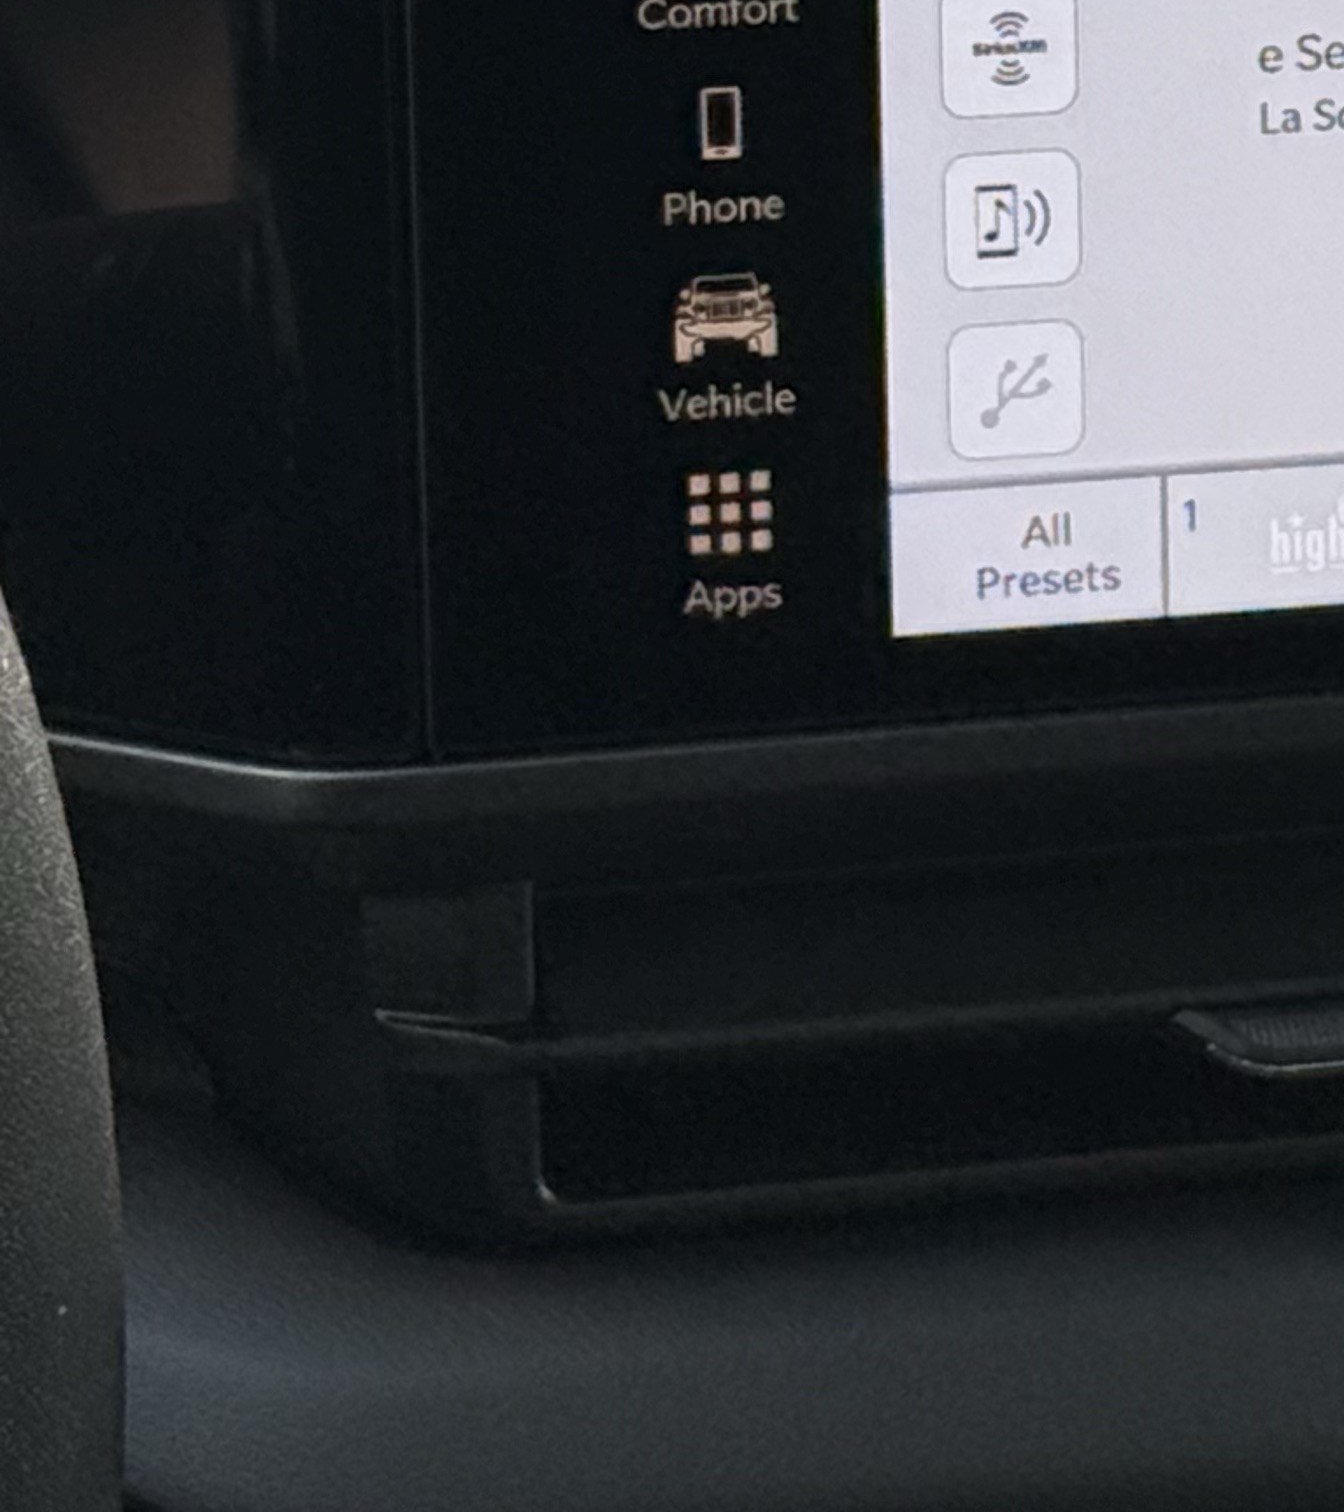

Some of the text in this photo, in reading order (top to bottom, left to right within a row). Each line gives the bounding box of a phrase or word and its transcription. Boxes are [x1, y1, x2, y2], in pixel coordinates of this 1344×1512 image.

[1258, 44, 1285, 74] e
[1259, 101, 1301, 135] La
[662, 192, 786, 227] Phone
[659, 383, 797, 423] Vehicle
[1021, 512, 1071, 549] All
[1184, 499, 1198, 531] 1
[976, 562, 1122, 599] Presets
[683, 579, 784, 619] Apps
